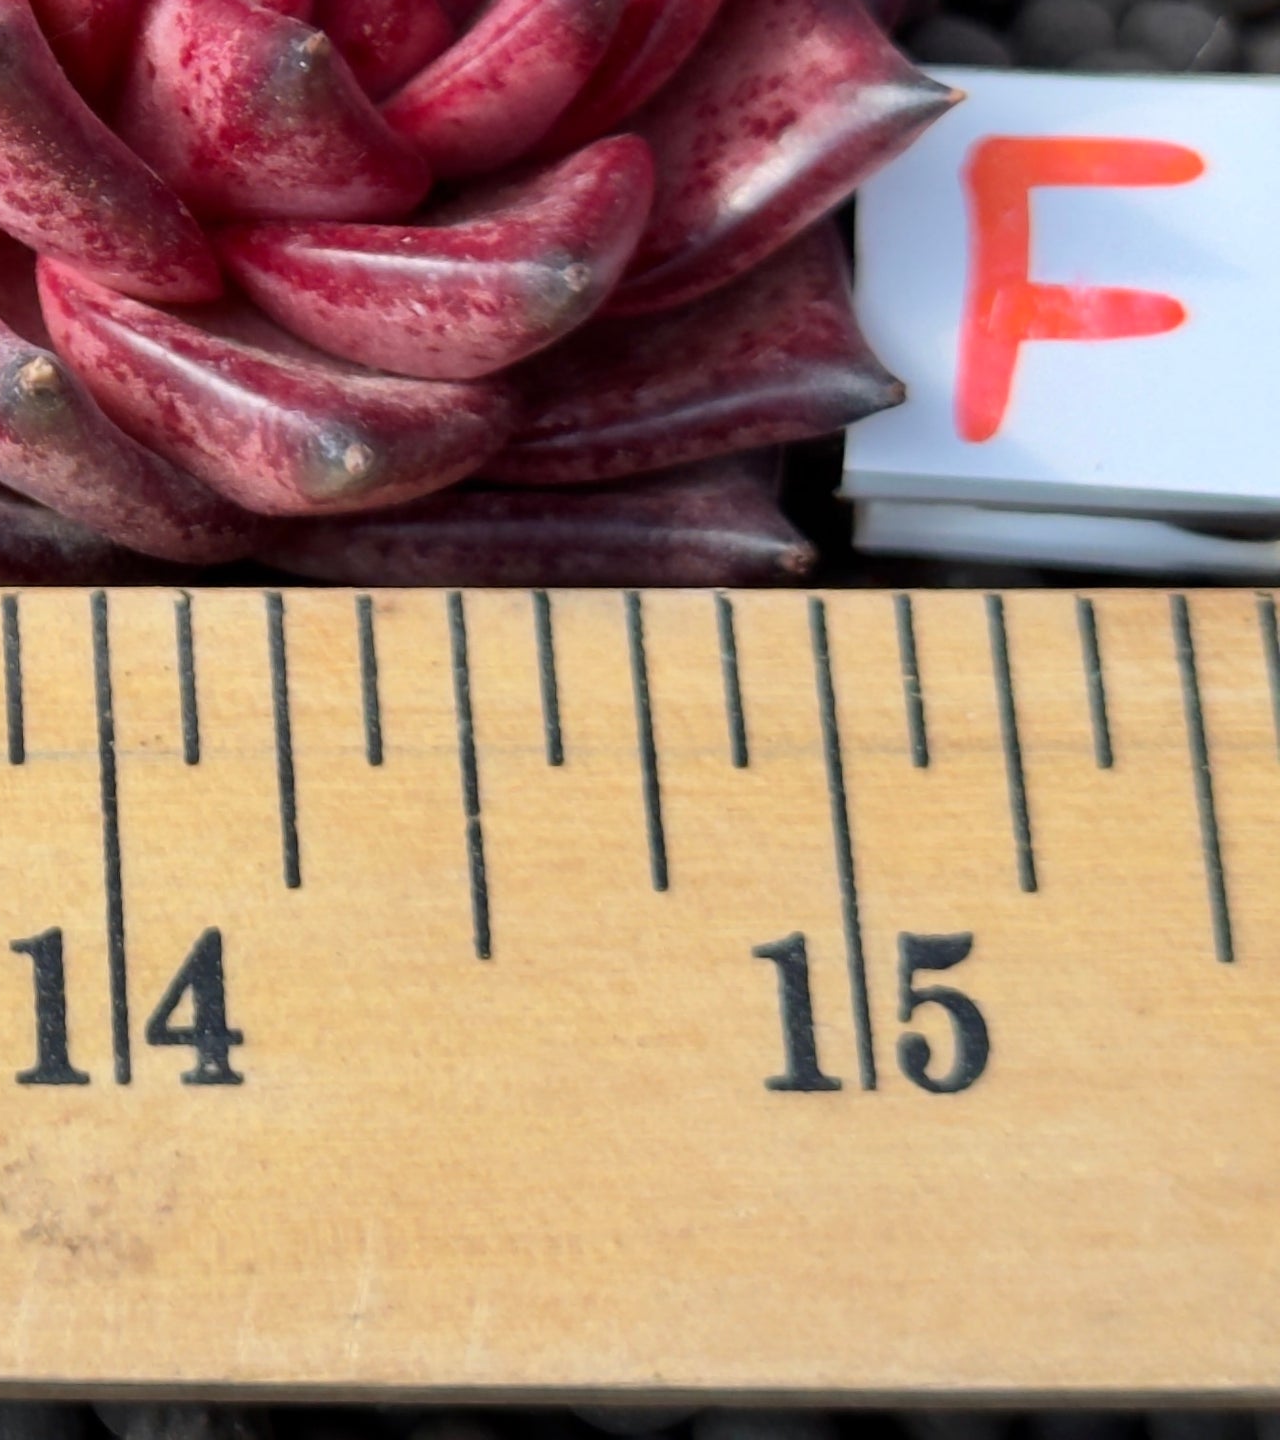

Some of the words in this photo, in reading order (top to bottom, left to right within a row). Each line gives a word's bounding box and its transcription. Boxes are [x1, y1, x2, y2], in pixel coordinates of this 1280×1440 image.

[956, 135, 1207, 444] F
[10, 927, 245, 1086] 14
[752, 931, 992, 1094] 15
